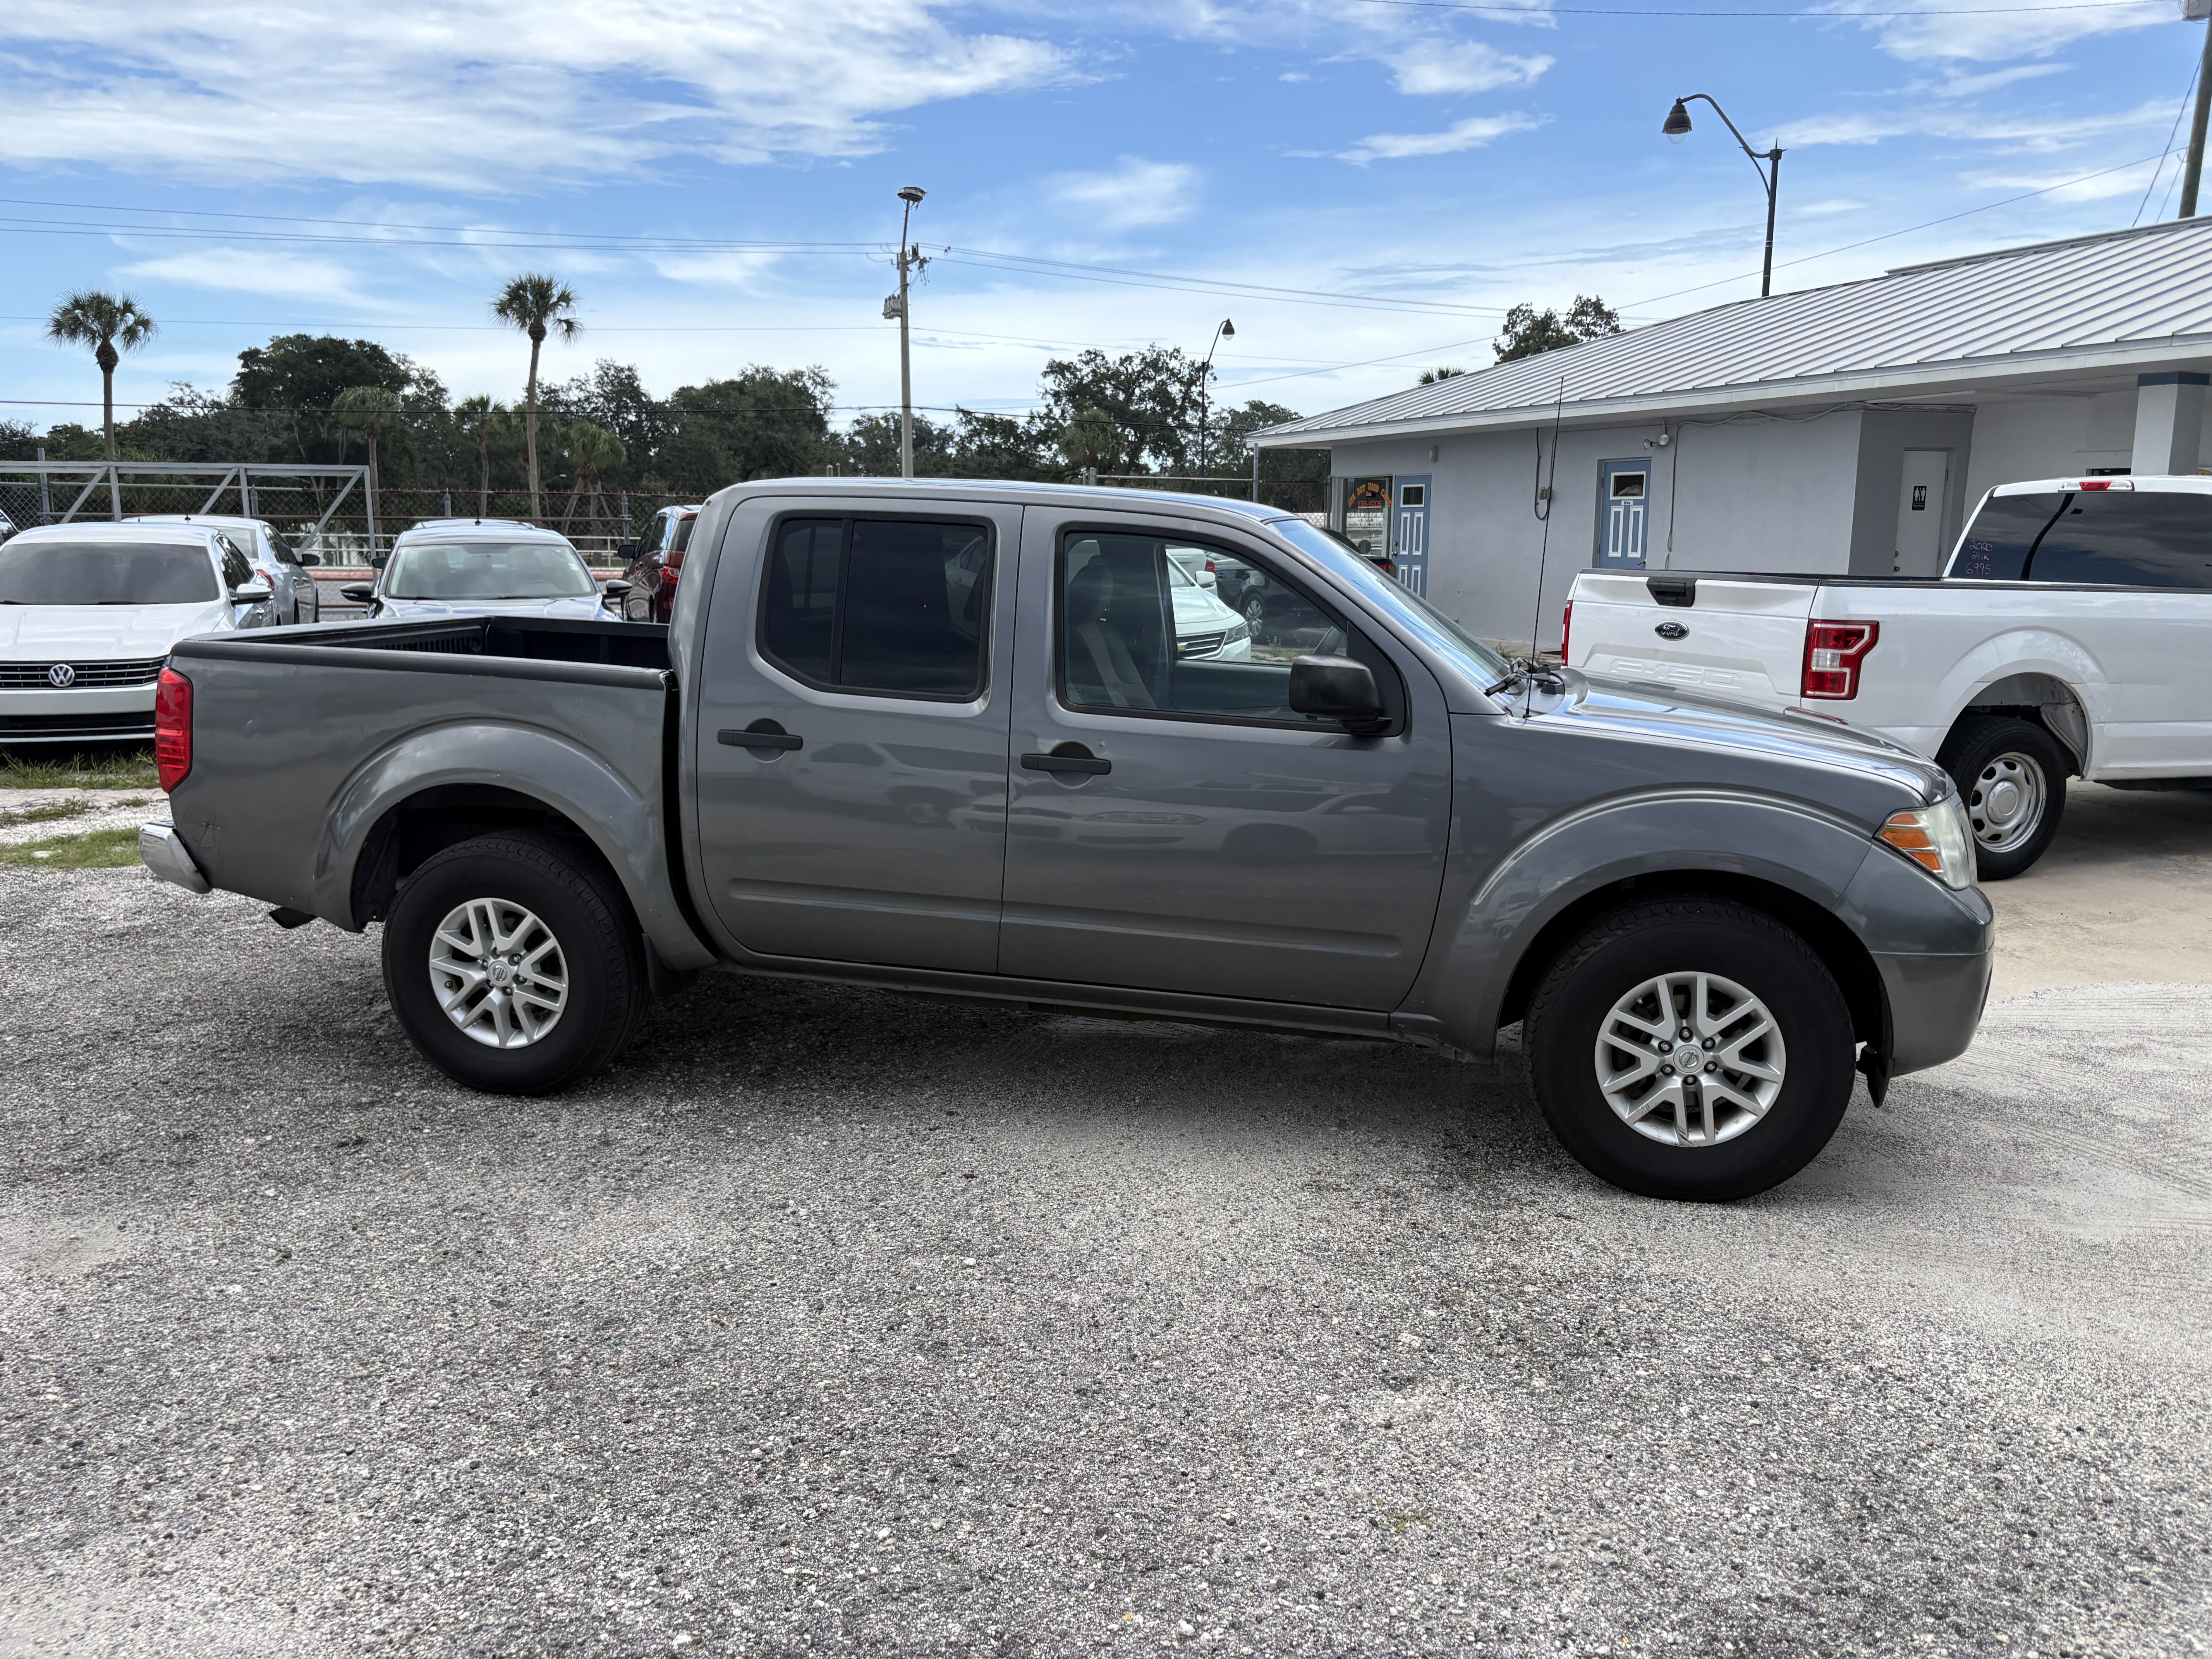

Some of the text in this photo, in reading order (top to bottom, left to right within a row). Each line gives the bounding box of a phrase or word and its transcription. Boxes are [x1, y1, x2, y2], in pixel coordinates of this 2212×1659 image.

[1969, 540, 1993, 551] 2020
[1966, 562, 1991, 575] 6995
[1661, 624, 1680, 636] Ford
[1610, 658, 1741, 689] F-150
